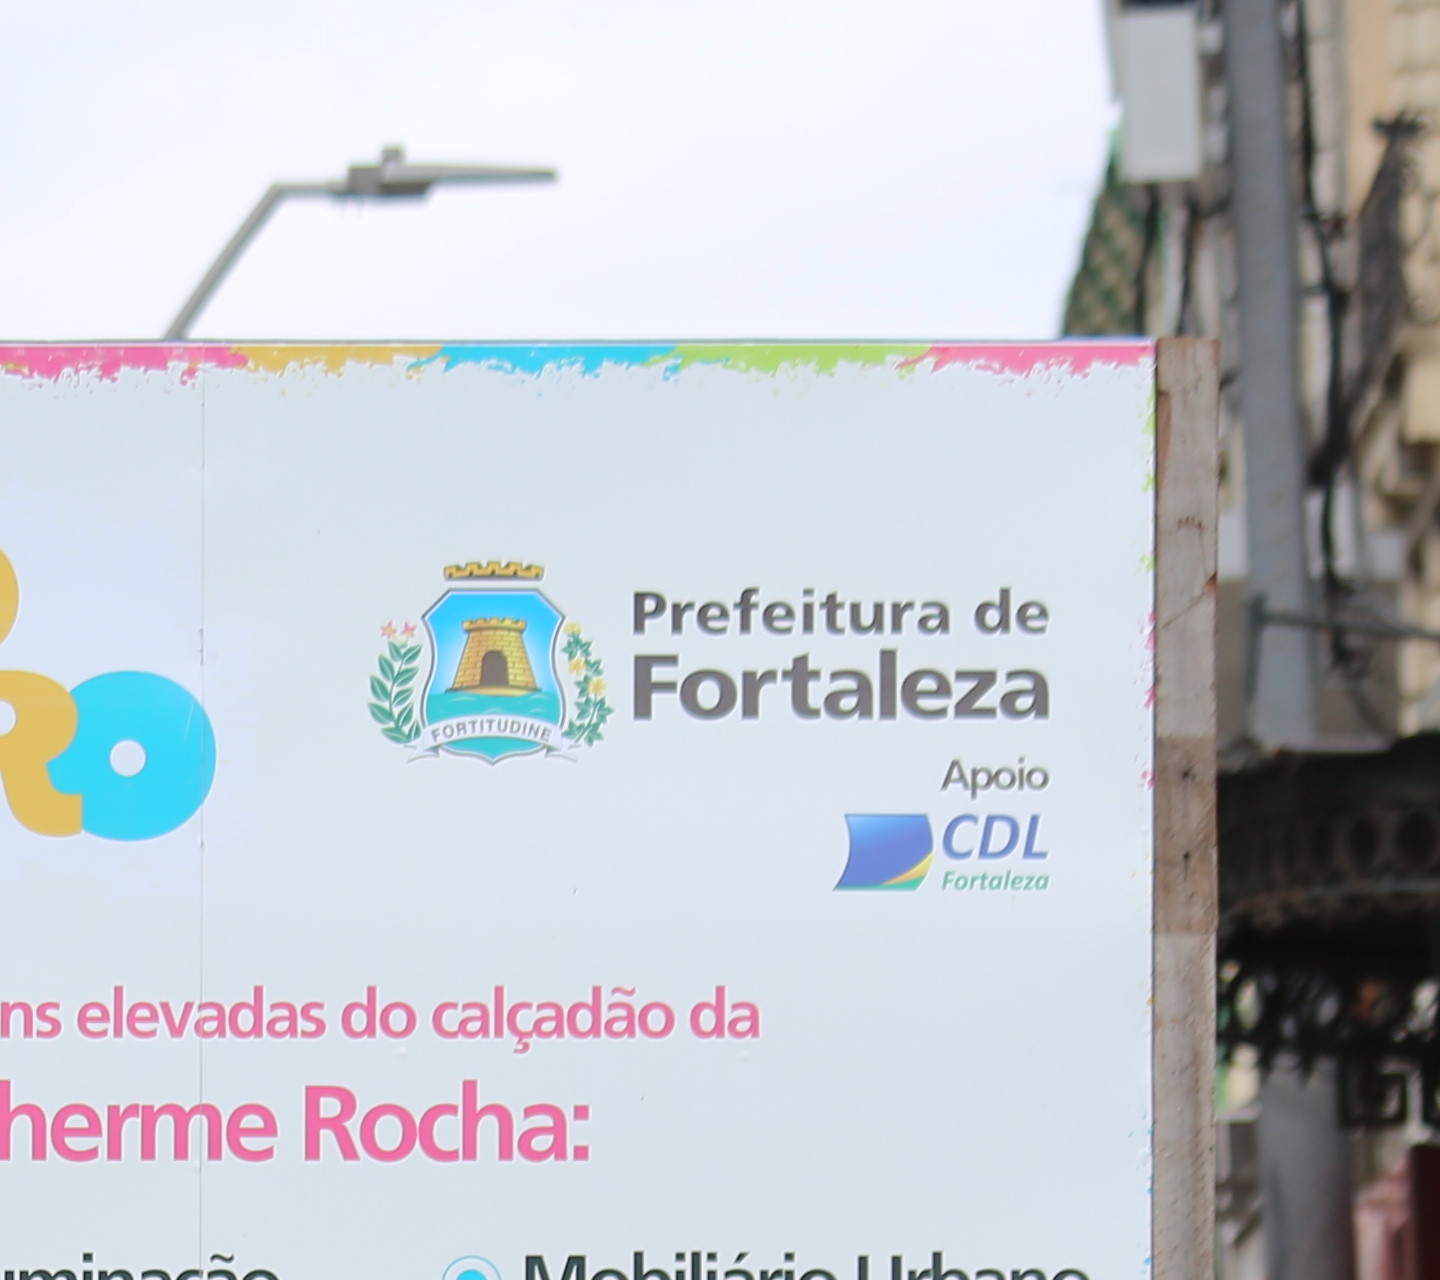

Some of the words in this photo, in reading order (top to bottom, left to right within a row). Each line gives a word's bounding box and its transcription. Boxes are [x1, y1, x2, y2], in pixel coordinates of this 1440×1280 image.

[633, 587, 950, 635] Prefeitura
[974, 587, 1049, 635] de
[633, 648, 1049, 720] Fortaleza
[430, 719, 553, 743] FORTITUDINE
[941, 757, 1049, 799] Apoio
[942, 814, 1048, 860] CDL
[942, 870, 1049, 891] Fortaleza
[81, 986, 327, 1039] elevadas
[341, 986, 418, 1039] do
[432, 986, 676, 1053] calçadão
[690, 986, 760, 1039] da
[305, 1080, 590, 1162] Rocha:
